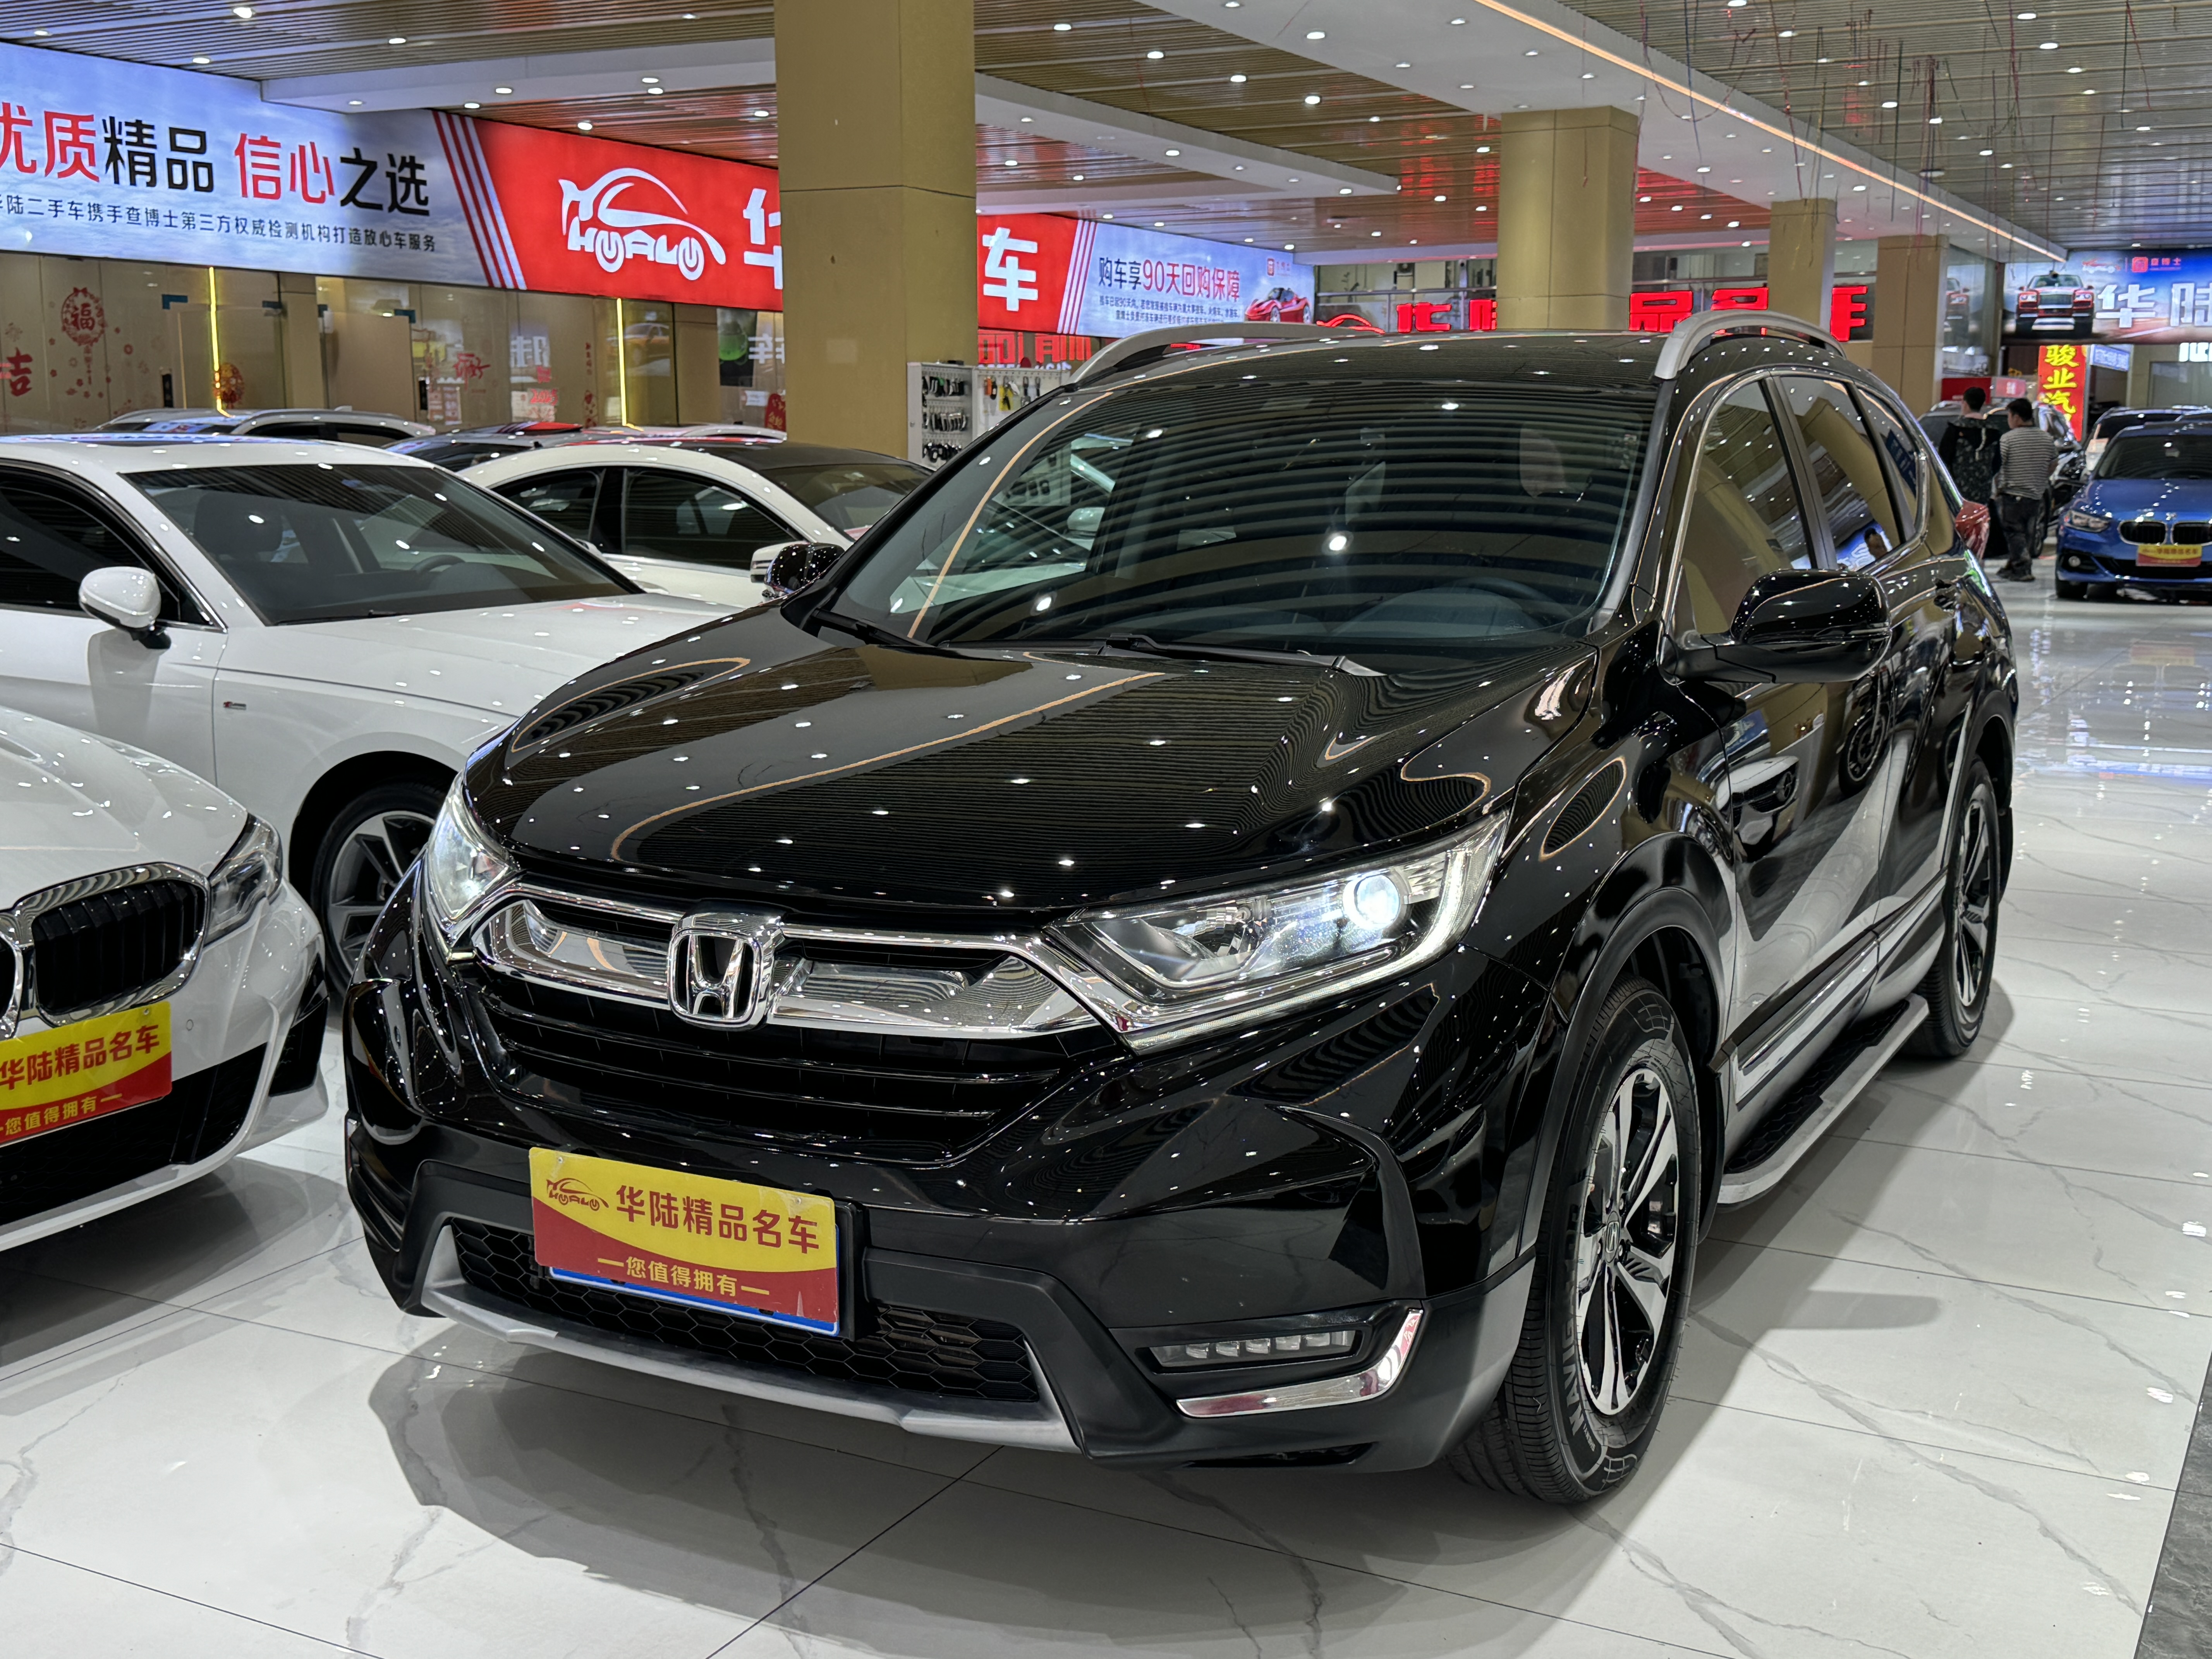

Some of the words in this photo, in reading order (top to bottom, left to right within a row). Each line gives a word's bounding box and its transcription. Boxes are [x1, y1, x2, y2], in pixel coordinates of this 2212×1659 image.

[0, 101, 215, 193] 优质精品
[234, 132, 430, 216] 信心之选
[982, 227, 1038, 311] 车
[1098, 257, 1240, 302] 购车享90天回购保障
[70, 302, 95, 331] 福
[7, 347, 33, 397] 吉
[2042, 344, 2080, 424] 骏业汽
[0, 1024, 160, 1091] 华陆精品名车
[616, 1185, 819, 1254] 华陆精品名车
